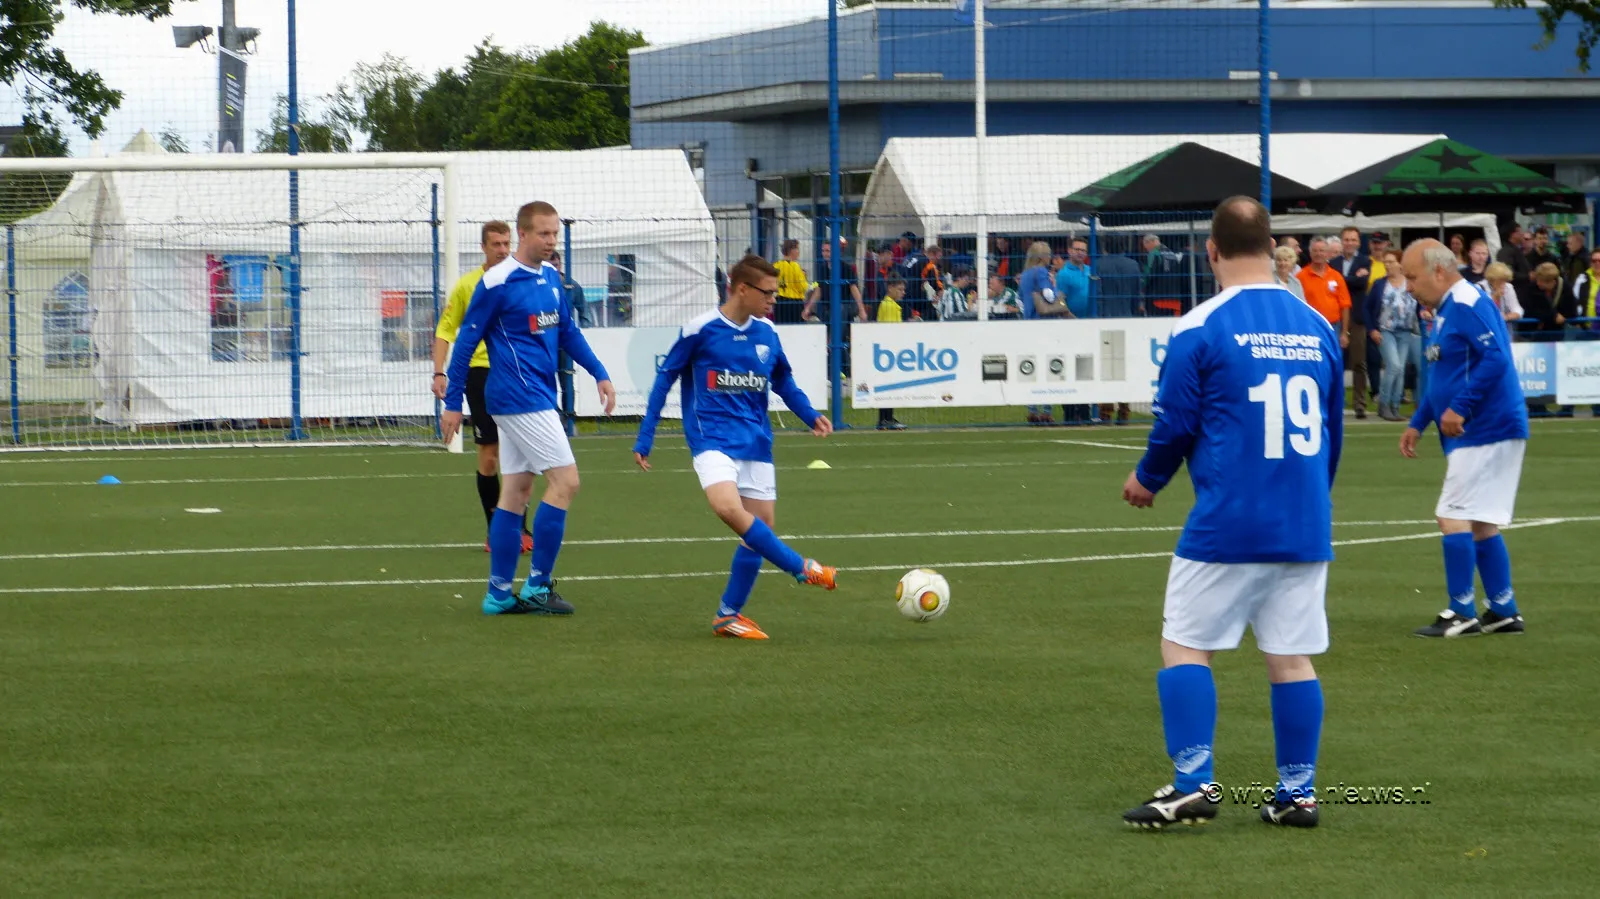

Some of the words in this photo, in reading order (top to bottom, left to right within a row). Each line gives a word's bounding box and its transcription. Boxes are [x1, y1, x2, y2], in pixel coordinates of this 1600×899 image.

[1248, 333, 1321, 348] INTERSPORT
[873, 342, 958, 372] beko
[1251, 346, 1323, 362] SNELDERS
[1514, 357, 1547, 374] ING
[716, 368, 767, 392] shoeby
[1248, 373, 1322, 459] 19
